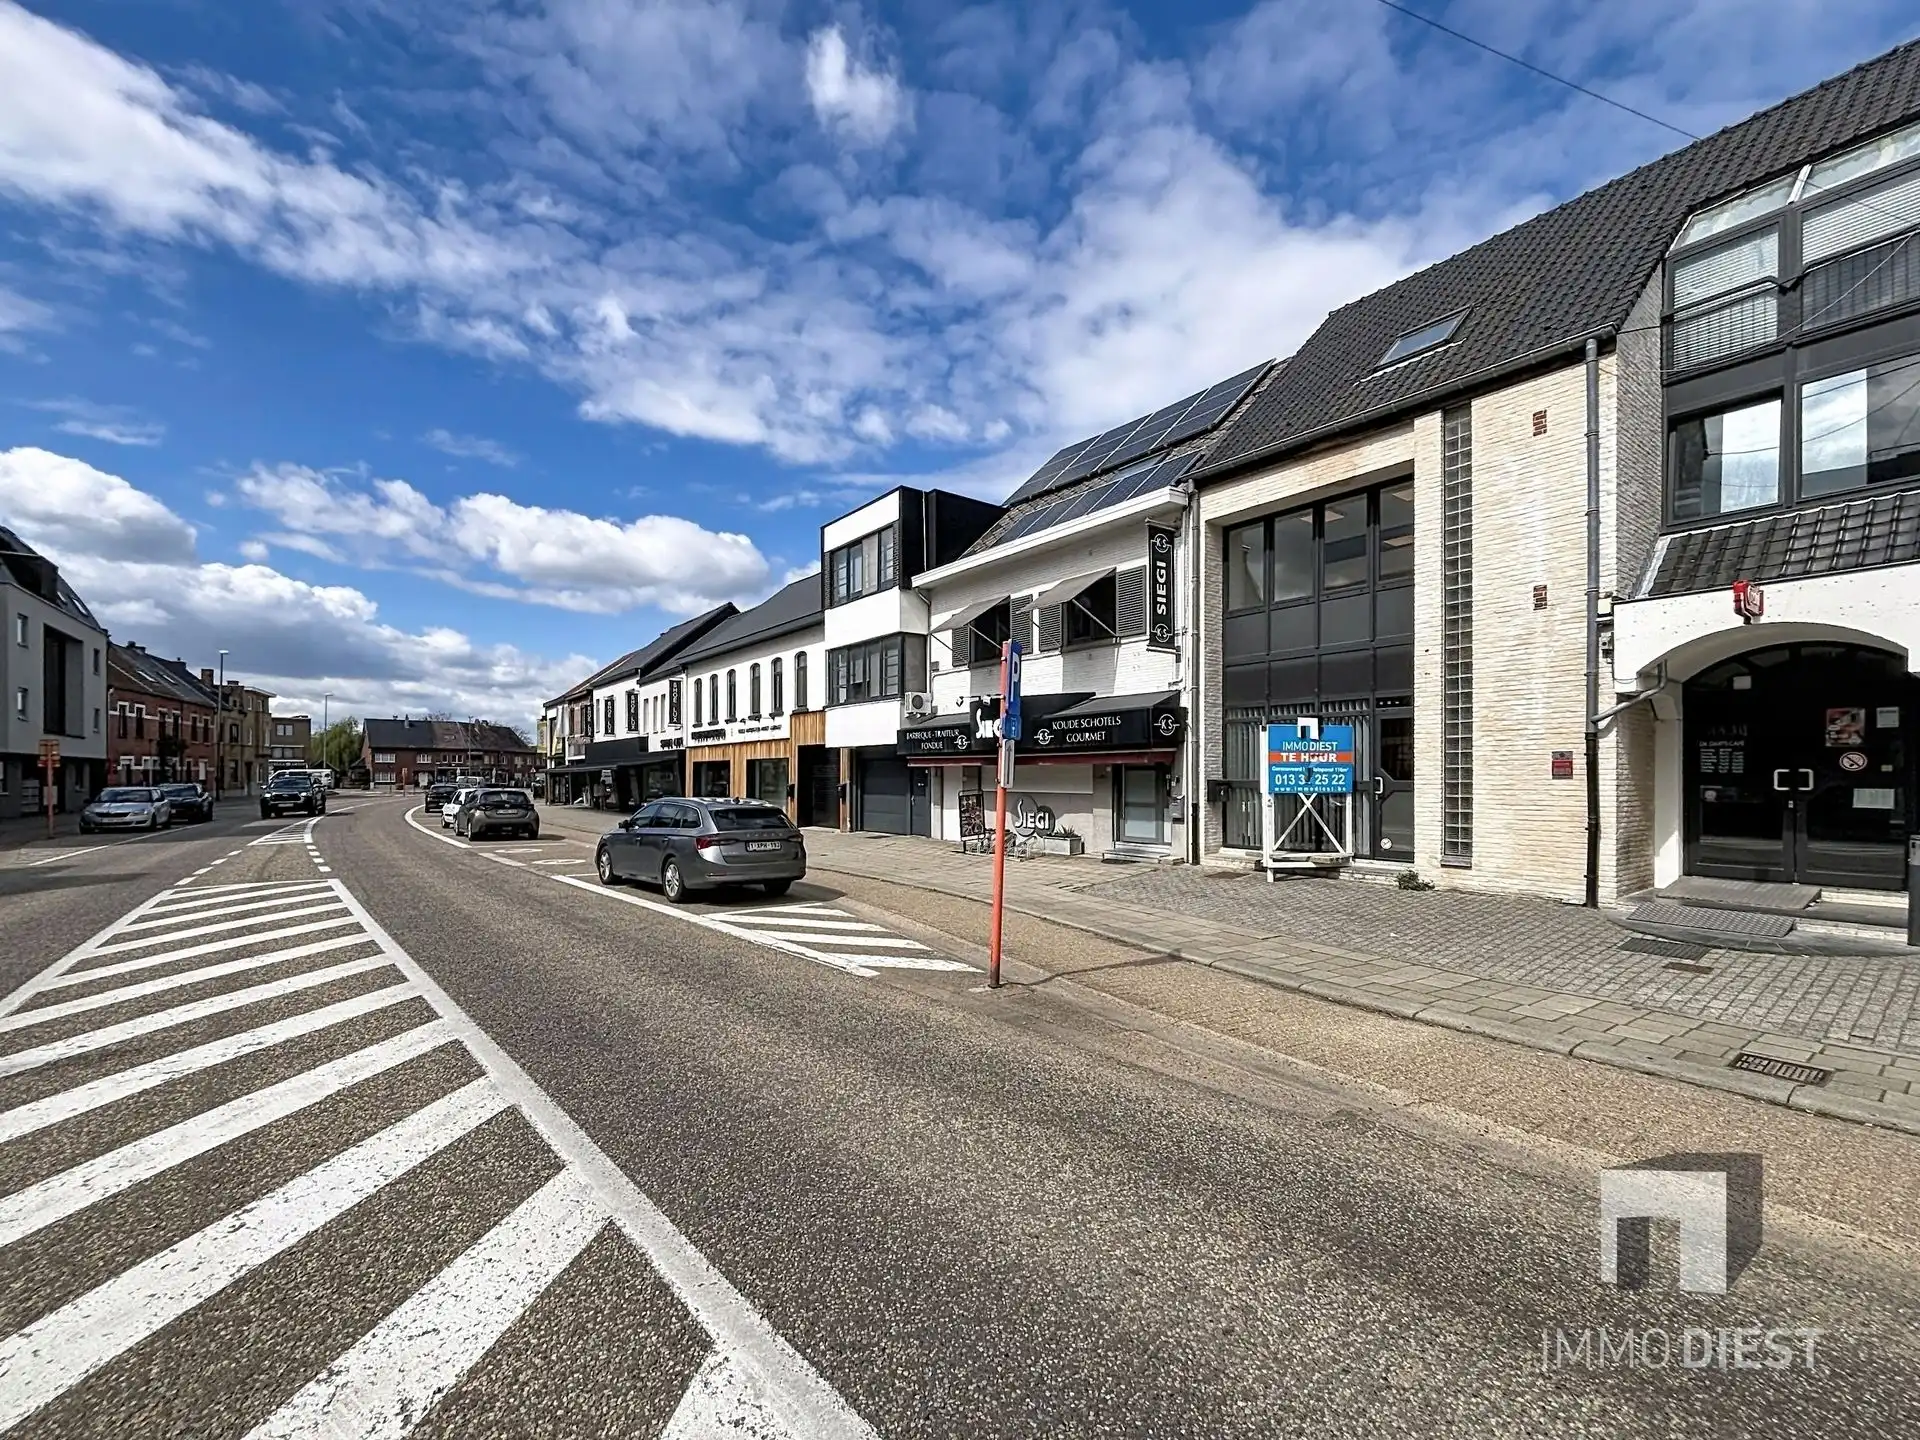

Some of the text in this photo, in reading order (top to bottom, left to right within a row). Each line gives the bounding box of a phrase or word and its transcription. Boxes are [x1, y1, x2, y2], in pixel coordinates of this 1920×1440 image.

[1156, 560, 1167, 616] SIEGI
[1010, 651, 1020, 703] P
[1052, 716, 1121, 730] KOUDE SCHOTELS
[1066, 731, 1106, 743] GOURMET
[1282, 741, 1338, 751] IMMO DIEST
[1280, 752, 1297, 762] TE
[1275, 774, 1296, 785] 013
[1314, 774, 1329, 785] 25
[1331, 774, 1346, 785] 22
[1014, 798, 1049, 830] SIEGI
